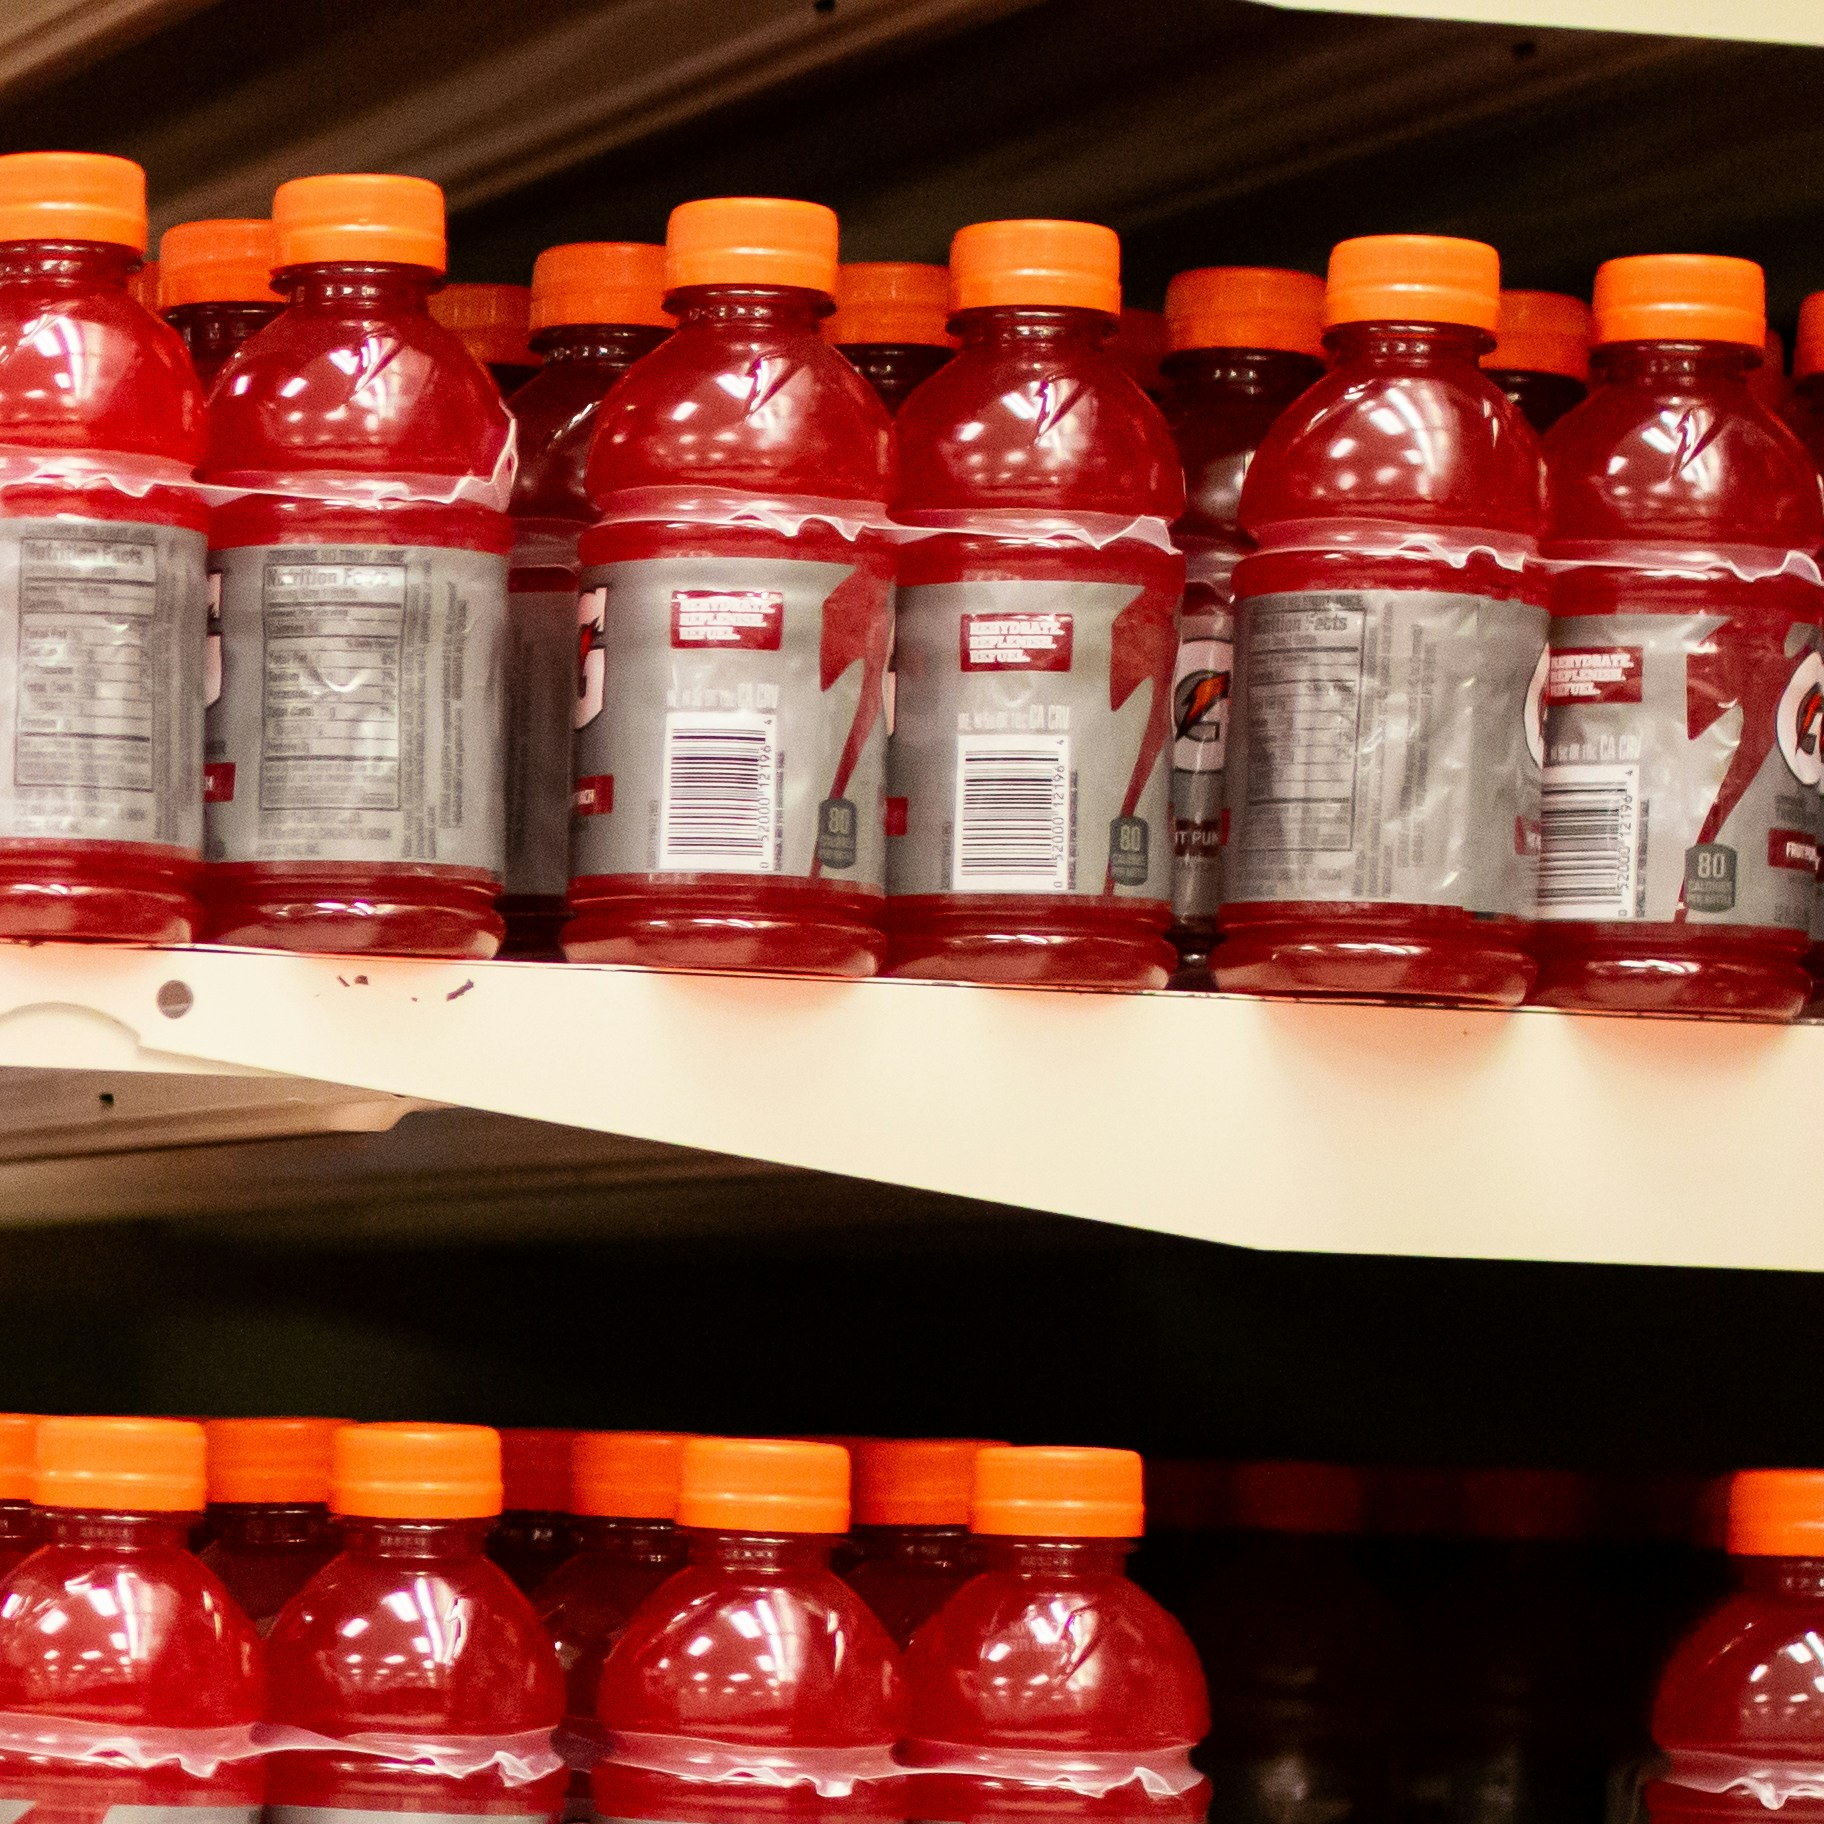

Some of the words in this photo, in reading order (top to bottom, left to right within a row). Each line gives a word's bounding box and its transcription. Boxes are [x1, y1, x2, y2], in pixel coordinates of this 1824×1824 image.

[759, 745, 772, 788] 12196
[1054, 765, 1065, 808] 12196
[758, 797, 770, 842] 52000
[828, 808, 848, 834] 80
[1119, 825, 1140, 851] 80
[1619, 795, 1632, 838] 12196
[1052, 816, 1064, 861] 52000
[1617, 845, 1631, 890] 52000
[1698, 852, 1725, 878] 80
